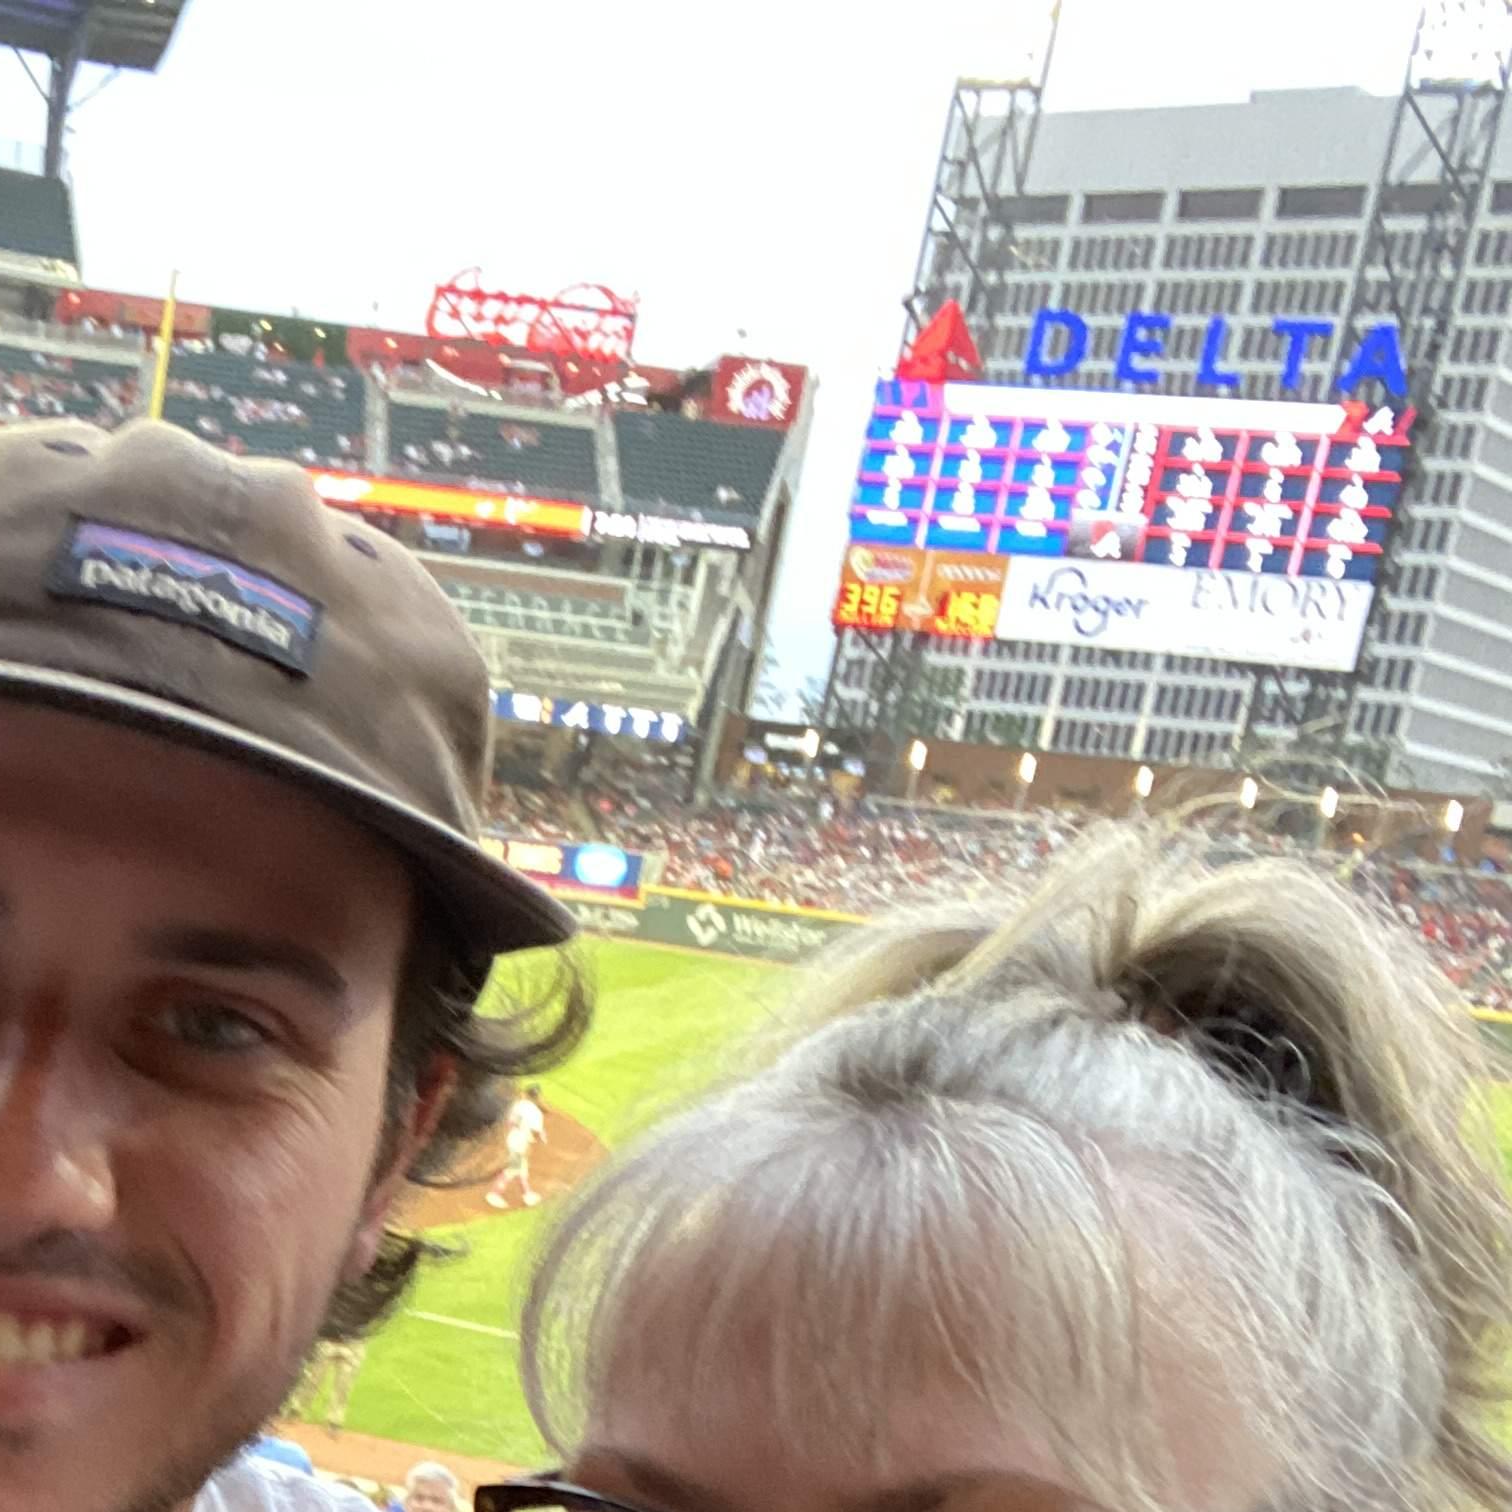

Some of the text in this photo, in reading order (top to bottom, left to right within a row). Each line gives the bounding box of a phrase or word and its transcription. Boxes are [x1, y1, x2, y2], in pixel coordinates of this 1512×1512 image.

[1024, 308, 1408, 397] DELTA
[80, 558, 290, 650] patagonia
[1029, 566, 1150, 638] Kroger
